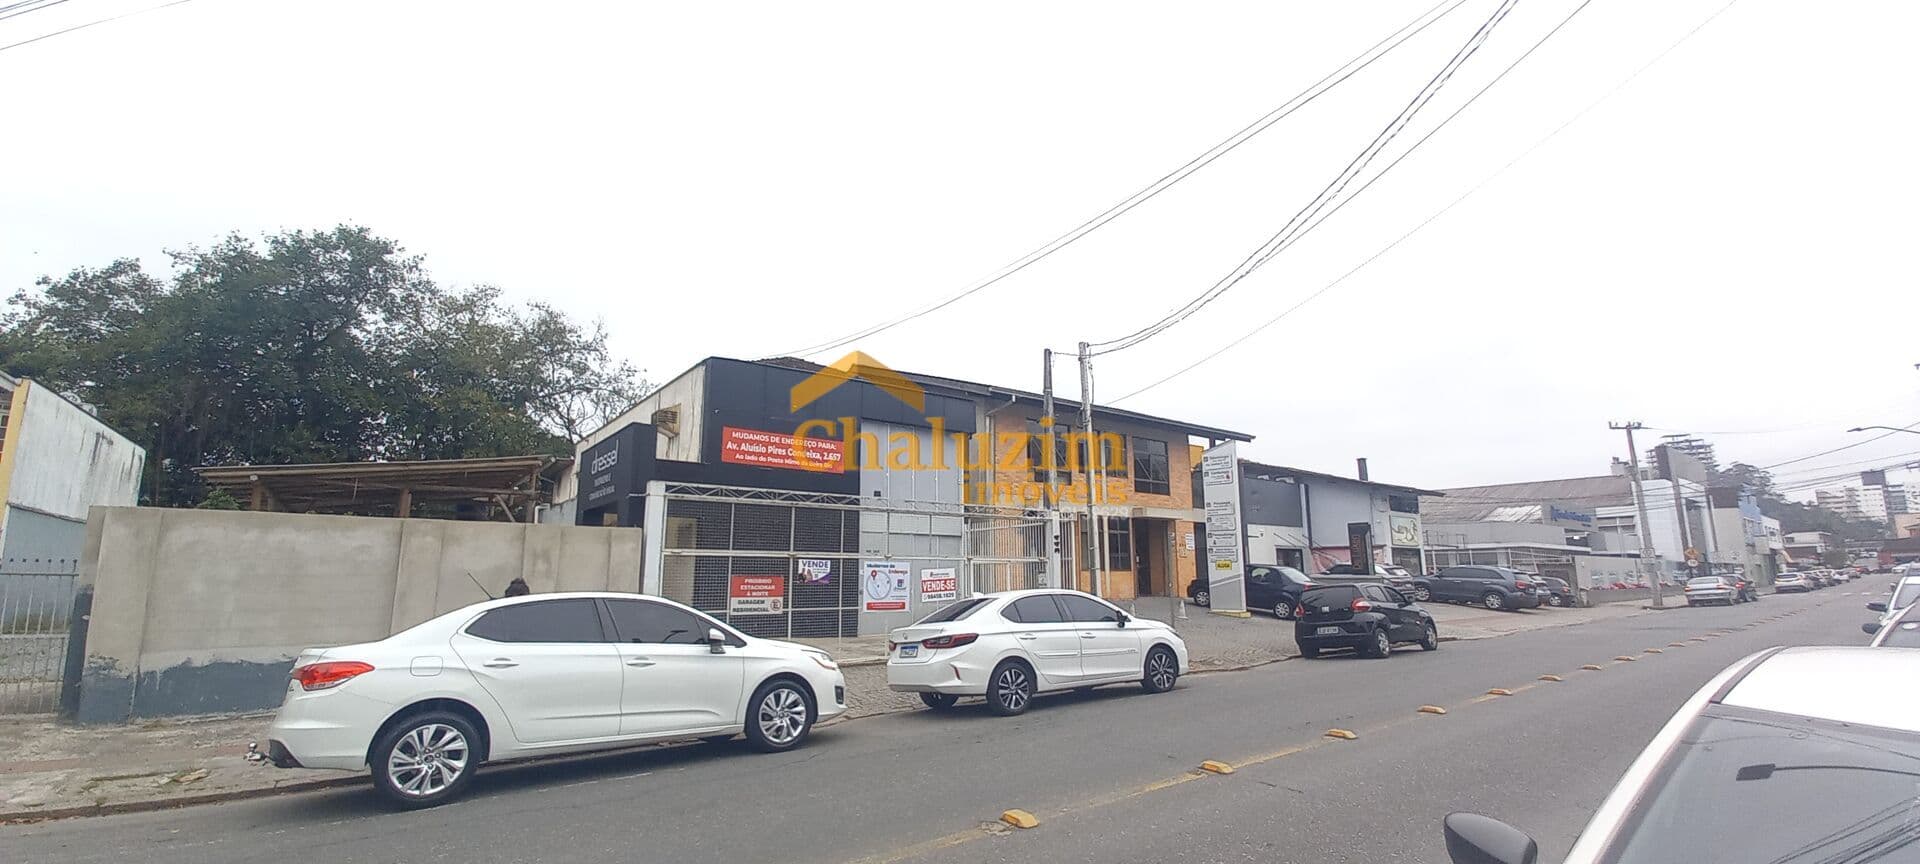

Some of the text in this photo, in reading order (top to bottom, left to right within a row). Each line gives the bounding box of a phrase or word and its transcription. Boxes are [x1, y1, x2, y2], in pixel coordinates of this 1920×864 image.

[726, 440, 739, 450] Av.
[740, 442, 767, 453] Aluísio
[768, 445, 786, 455] Pires
[732, 431, 769, 442] MUDAMOS
[781, 437, 817, 448] ENDEREÇO
[818, 442, 837, 450] PARA:
[591, 439, 619, 475] dressel
[802, 560, 829, 569] VENDE
[922, 580, 955, 592] VENDE-SE
